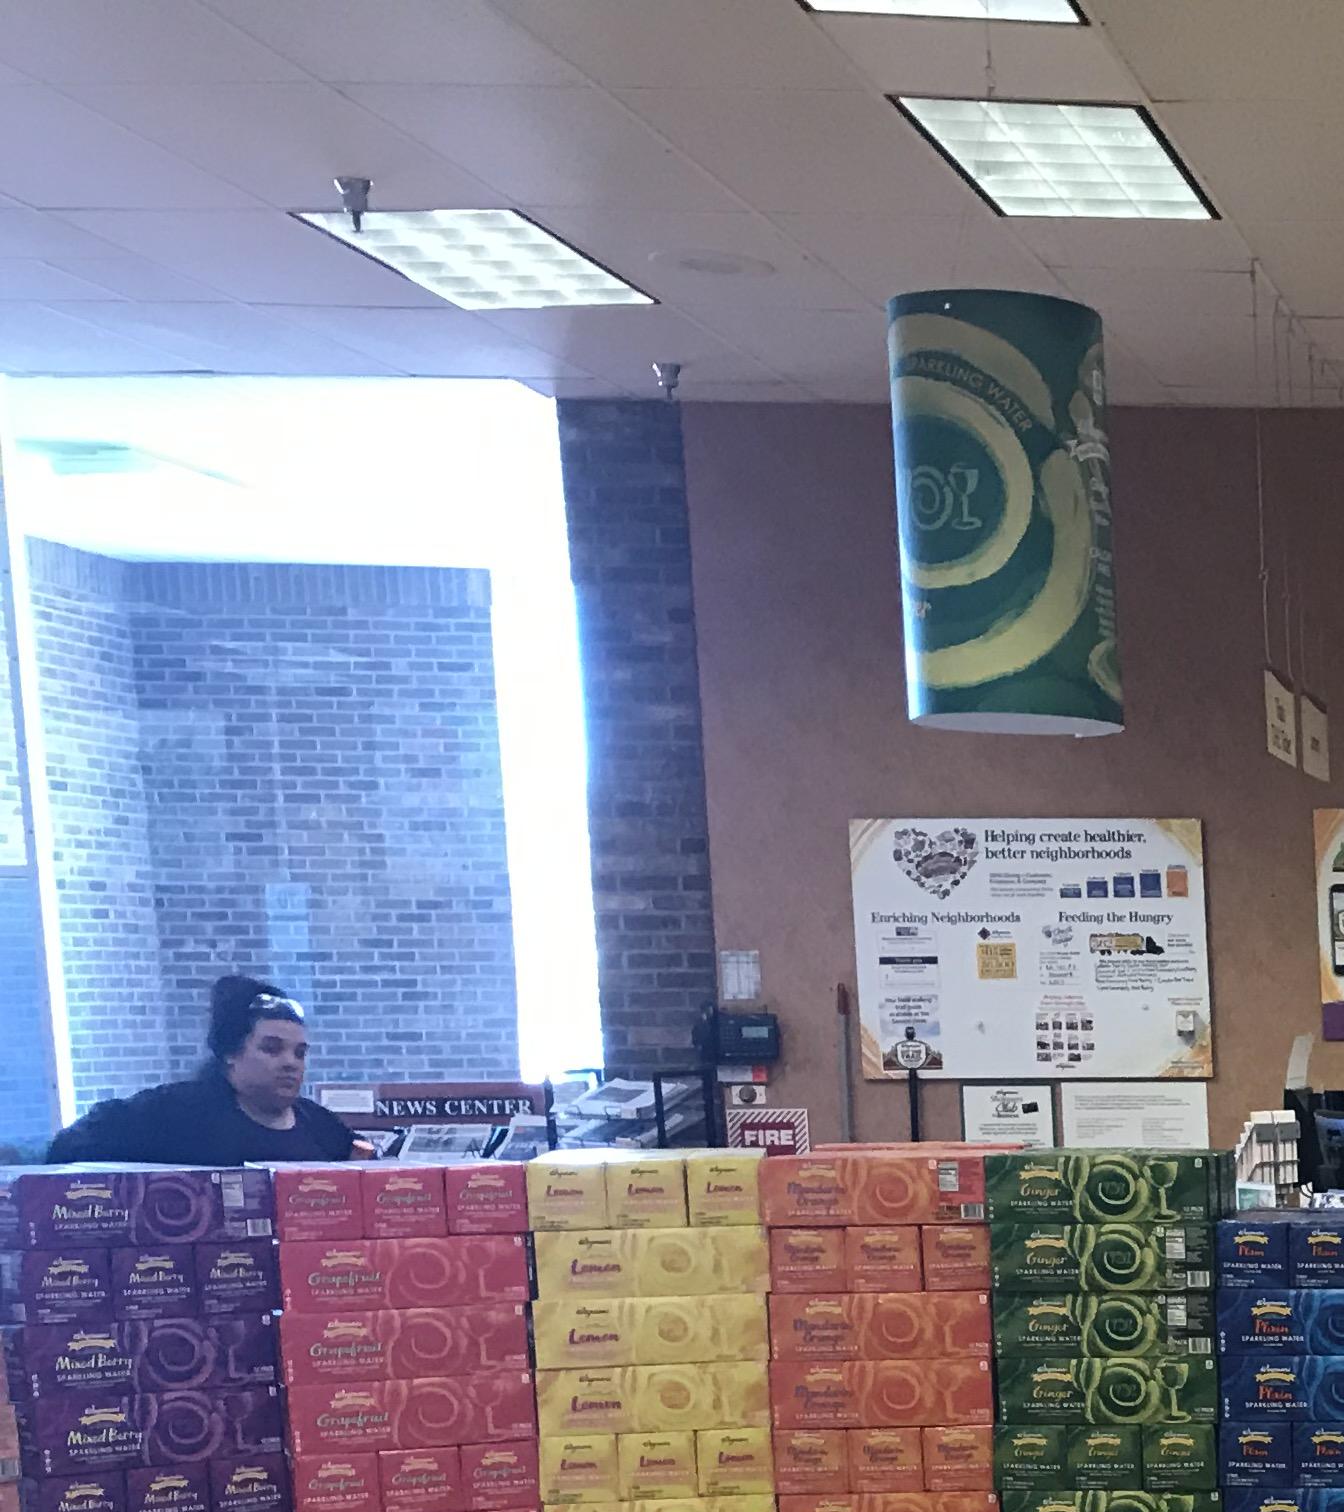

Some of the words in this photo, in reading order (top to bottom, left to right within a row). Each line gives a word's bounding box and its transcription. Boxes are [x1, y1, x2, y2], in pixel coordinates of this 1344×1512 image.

[987, 382, 1034, 433] WATER
[984, 829, 1036, 848] Helping
[1039, 830, 1081, 844] create
[1083, 828, 1147, 845] healthier,
[985, 847, 1027, 860] better
[1030, 847, 1132, 863] neighborhoods
[871, 911, 929, 927] Enriching
[931, 911, 1021, 927] Neighborhoods
[1058, 911, 1103, 926] Feeding
[1106, 911, 1127, 924] the
[1129, 911, 1174, 926] Hungry
[375, 1099, 437, 1117] NEWS
[444, 1097, 533, 1116] CENTER
[744, 1128, 794, 1147] FIRE
